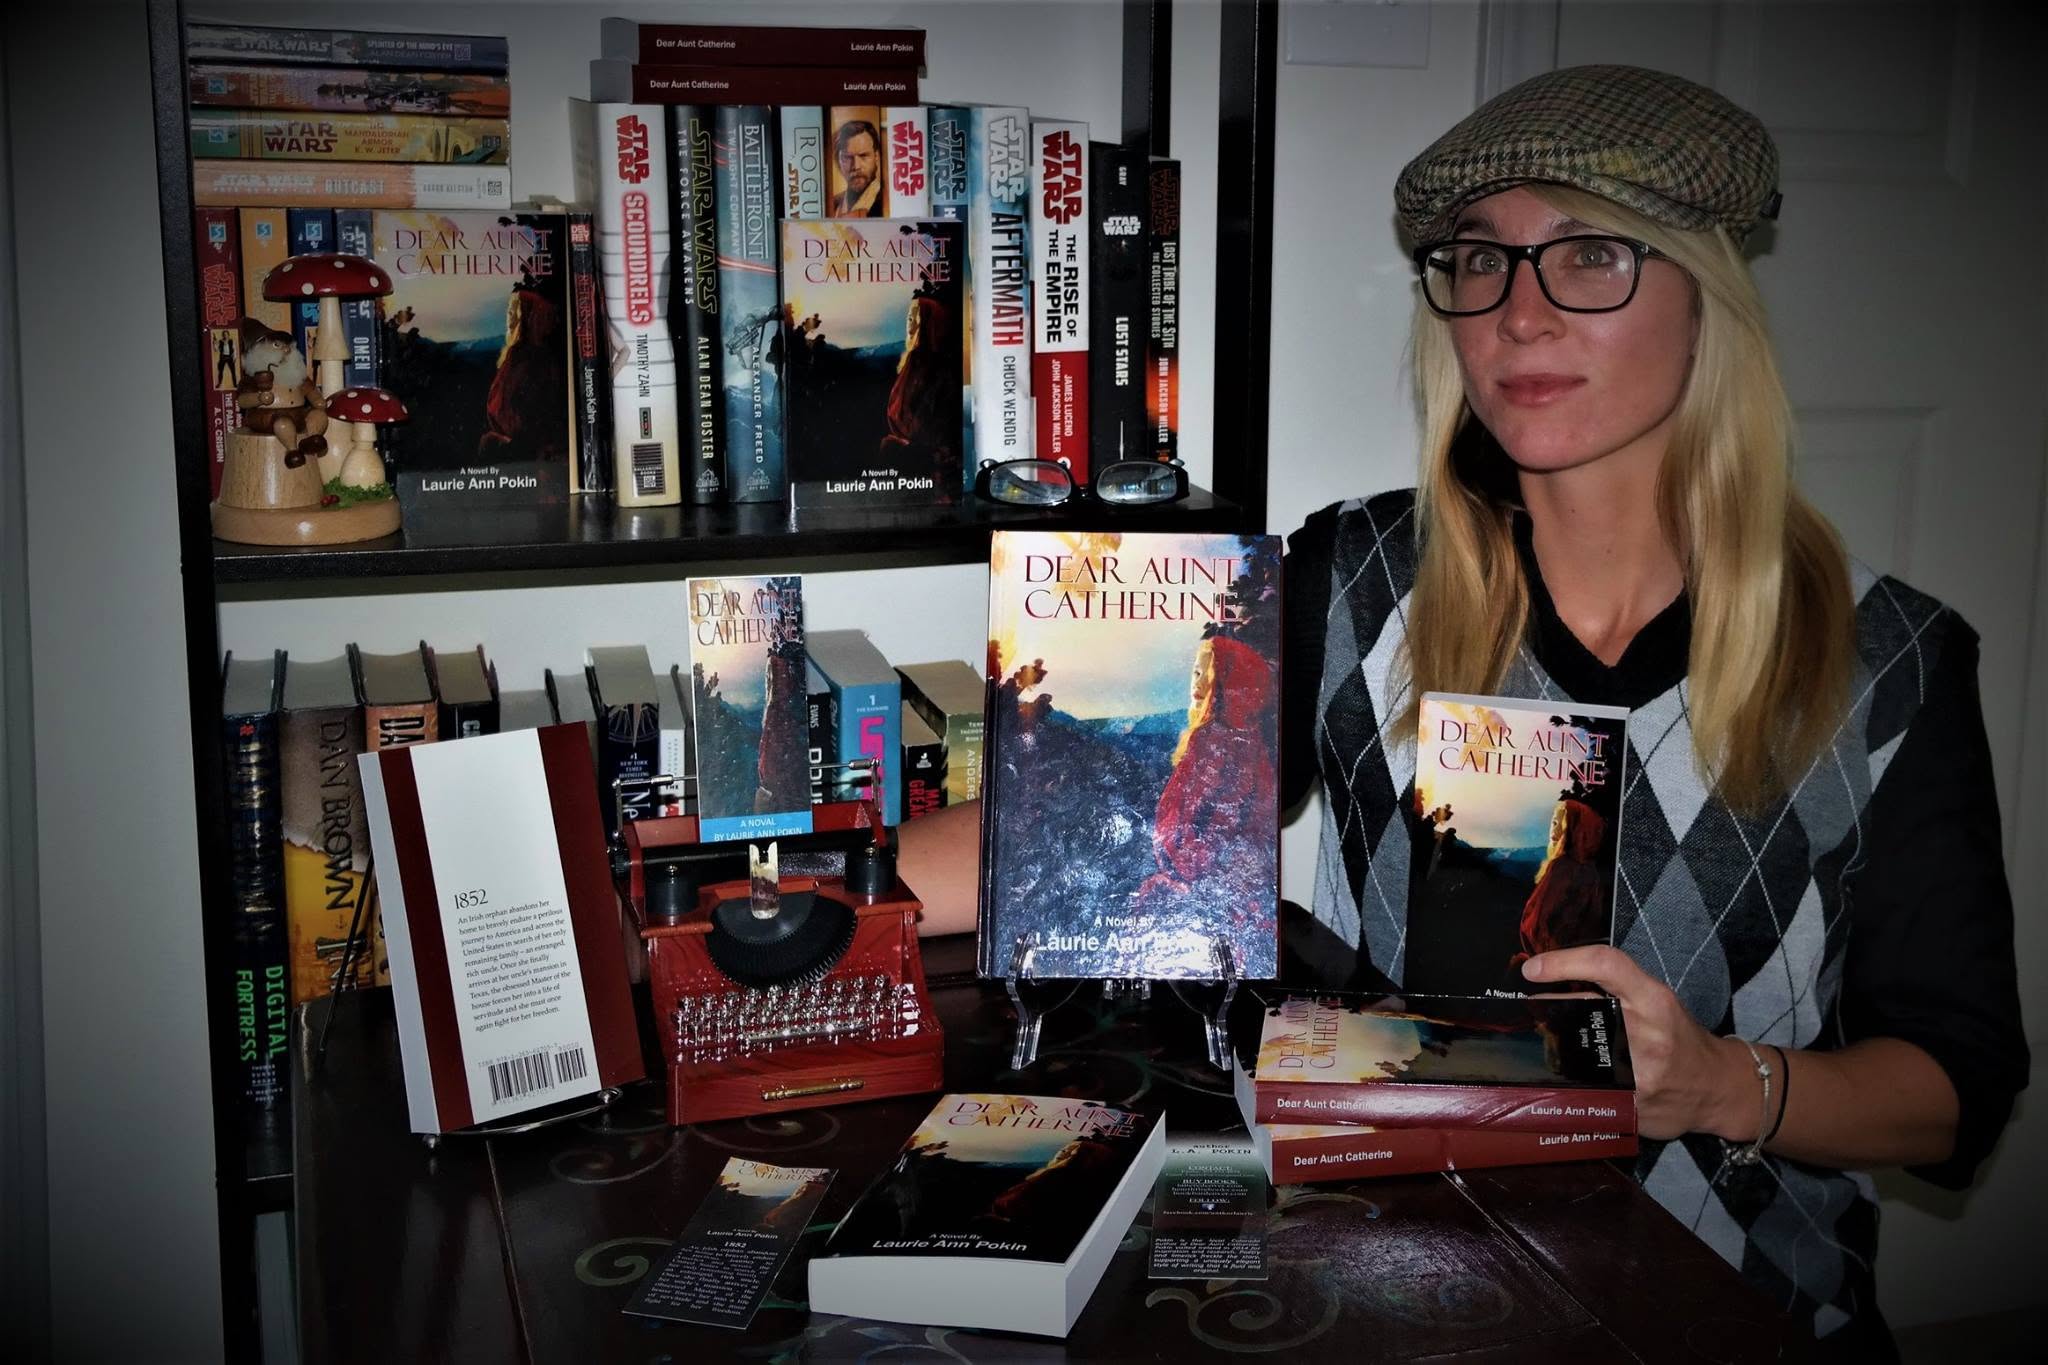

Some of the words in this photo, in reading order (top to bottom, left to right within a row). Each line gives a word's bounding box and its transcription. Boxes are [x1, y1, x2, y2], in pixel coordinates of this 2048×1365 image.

[656, 39, 674, 48] Dear
[676, 39, 695, 48] Aunt
[698, 39, 736, 49] Catherine
[851, 42, 874, 51] Laurie
[876, 43, 888, 51] Ann
[890, 43, 914, 52] Pokin
[650, 80, 668, 89] Dear
[670, 80, 689, 89] Aunt
[691, 80, 729, 90] Catherine
[843, 82, 867, 91] Laurie
[868, 82, 881, 91] Ann
[883, 83, 906, 92] Pokin
[264, 122, 337, 137] STAR
[678, 129, 687, 156] THE
[265, 137, 338, 152] WARS
[617, 116, 635, 183] WARS
[633, 115, 649, 183] STAR
[893, 121, 909, 196] WARS
[908, 121, 924, 196] STAR
[690, 118, 713, 217] STAR
[932, 121, 951, 200] WARS
[950, 120, 967, 200] STAR
[800, 136, 819, 215] ROGU
[1043, 131, 1062, 224] WARS
[1063, 131, 1081, 224] STAR
[680, 168, 690, 220] FORCE
[744, 125, 764, 258] BATTLEFRONT
[1103, 216, 1141, 226] STAR
[1103, 225, 1140, 236] WARS
[396, 230, 465, 251] DEAR
[479, 229, 552, 251] AUNT
[805, 239, 873, 259] DEAR
[883, 238, 950, 259] AUNT
[1049, 230, 1059, 257] THE
[1066, 234, 1076, 262] THE
[1162, 242, 1176, 266] LOST
[397, 254, 553, 276] CATHERINE
[625, 193, 651, 324] SCOUNDRELS
[682, 230, 694, 305] AWAKENS
[695, 217, 717, 314] WARS
[805, 262, 950, 283] CATHERINE
[992, 212, 1024, 345] AFTERMATH
[1064, 265, 1079, 315] RISE
[1152, 265, 1160, 306] COLLECTED
[1163, 266, 1176, 291] TRIBE
[1047, 262, 1061, 343] EMPIRE
[1067, 319, 1076, 337] OF
[1116, 317, 1129, 349] LOST
[1152, 308, 1160, 339] STORIES
[353, 337, 371, 370] OMEN
[637, 334, 648, 370] TIMOTHY
[698, 337, 711, 372] ALAN
[1158, 357, 1168, 376] JOHN
[584, 367, 595, 396] James
[751, 347, 762, 419] ALEXANDER
[1003, 356, 1015, 398] CHUCK
[1052, 359, 1060, 382] JOHN
[1116, 352, 1129, 386] STARS
[639, 372, 650, 398] ZAHN
[699, 375, 712, 409] DEAN
[1064, 374, 1072, 403] JAMES
[1159, 378, 1168, 411] JACKSON
[586, 396, 595, 423] Kahn
[1052, 384, 1060, 423] JACKSON
[1004, 400, 1016, 446] WENDIG
[1065, 405, 1073, 437] LUCENO
[1158, 413, 1168, 443] MILLER
[700, 413, 714, 460] FOSTER
[755, 424, 763, 464] FREED
[1052, 424, 1060, 454] MILLER
[422, 477, 465, 492] Laurie
[468, 476, 496, 489] Ann
[499, 476, 537, 489] Pokin
[469, 467, 487, 475] Novel
[827, 479, 866, 493] Laurie
[868, 478, 895, 490] Ann
[898, 478, 933, 489] Pokin
[1025, 555, 1130, 584] DEAR
[1141, 556, 1240, 585] AUNT
[696, 592, 744, 618] DEAR
[750, 588, 798, 614] AUNT
[1025, 589, 1238, 623] CATHERINE
[697, 616, 798, 645] CATHERINE
[869, 695, 875, 705] 1
[810, 704, 819, 728] EVANS
[320, 718, 348, 788] DAN
[1440, 719, 1514, 749] DEAR
[1528, 729, 1608, 758] AUNT
[1439, 747, 1605, 786] CATHERINE
[714, 833, 722, 841] BY
[724, 831, 754, 840] LAURIE
[757, 830, 774, 838] ANN
[776, 828, 802, 837] POKIN
[749, 818, 776, 827] NOVAL
[323, 796, 353, 910] BROWN
[454, 887, 488, 910] 1852
[469, 913, 483, 922] Irish
[484, 908, 506, 920] orphan
[508, 902, 538, 913] abandons
[459, 925, 477, 935] home
[485, 919, 508, 929] bravely
[509, 913, 531, 924] endure
[537, 907, 562, 918] perilous
[494, 927, 520, 937] America
[521, 924, 533, 932] and
[535, 921, 553, 930] across
[1106, 916, 1136, 927] Novel
[462, 946, 484, 956] United
[485, 941, 504, 951] States
[512, 935, 533, 945] search
[552, 927, 566, 937] only
[1036, 932, 1100, 950] Laurie
[1493, 989, 1516, 998] Novel
[236, 969, 257, 1062] FORTRESS
[265, 965, 287, 1059] DIGITAL
[1592, 1011, 1604, 1029] Pokin
[1279, 1032, 1307, 1068] DEAR
[1594, 1030, 1608, 1044] Ann
[1598, 1043, 1612, 1067] Laurie
[956, 1102, 1039, 1115] DEAR
[1053, 1107, 1144, 1125] AUNT
[1277, 1099, 1300, 1108] Dear
[1304, 1100, 1327, 1109] Aunt
[1531, 1106, 1562, 1115] Laurie
[1565, 1107, 1585, 1115] Ann
[1588, 1107, 1616, 1117] Pokin
[949, 1114, 1134, 1138] CATHERINE
[1539, 1134, 1569, 1145] Laurie
[1572, 1133, 1590, 1142] Ann
[1294, 1156, 1317, 1166] Dear
[1320, 1154, 1343, 1163] Aunt
[1346, 1150, 1392, 1162] Catherine
[872, 1240, 929, 1248] Laurie
[933, 1240, 970, 1248] Ann
[975, 1240, 1027, 1251] Pokin
